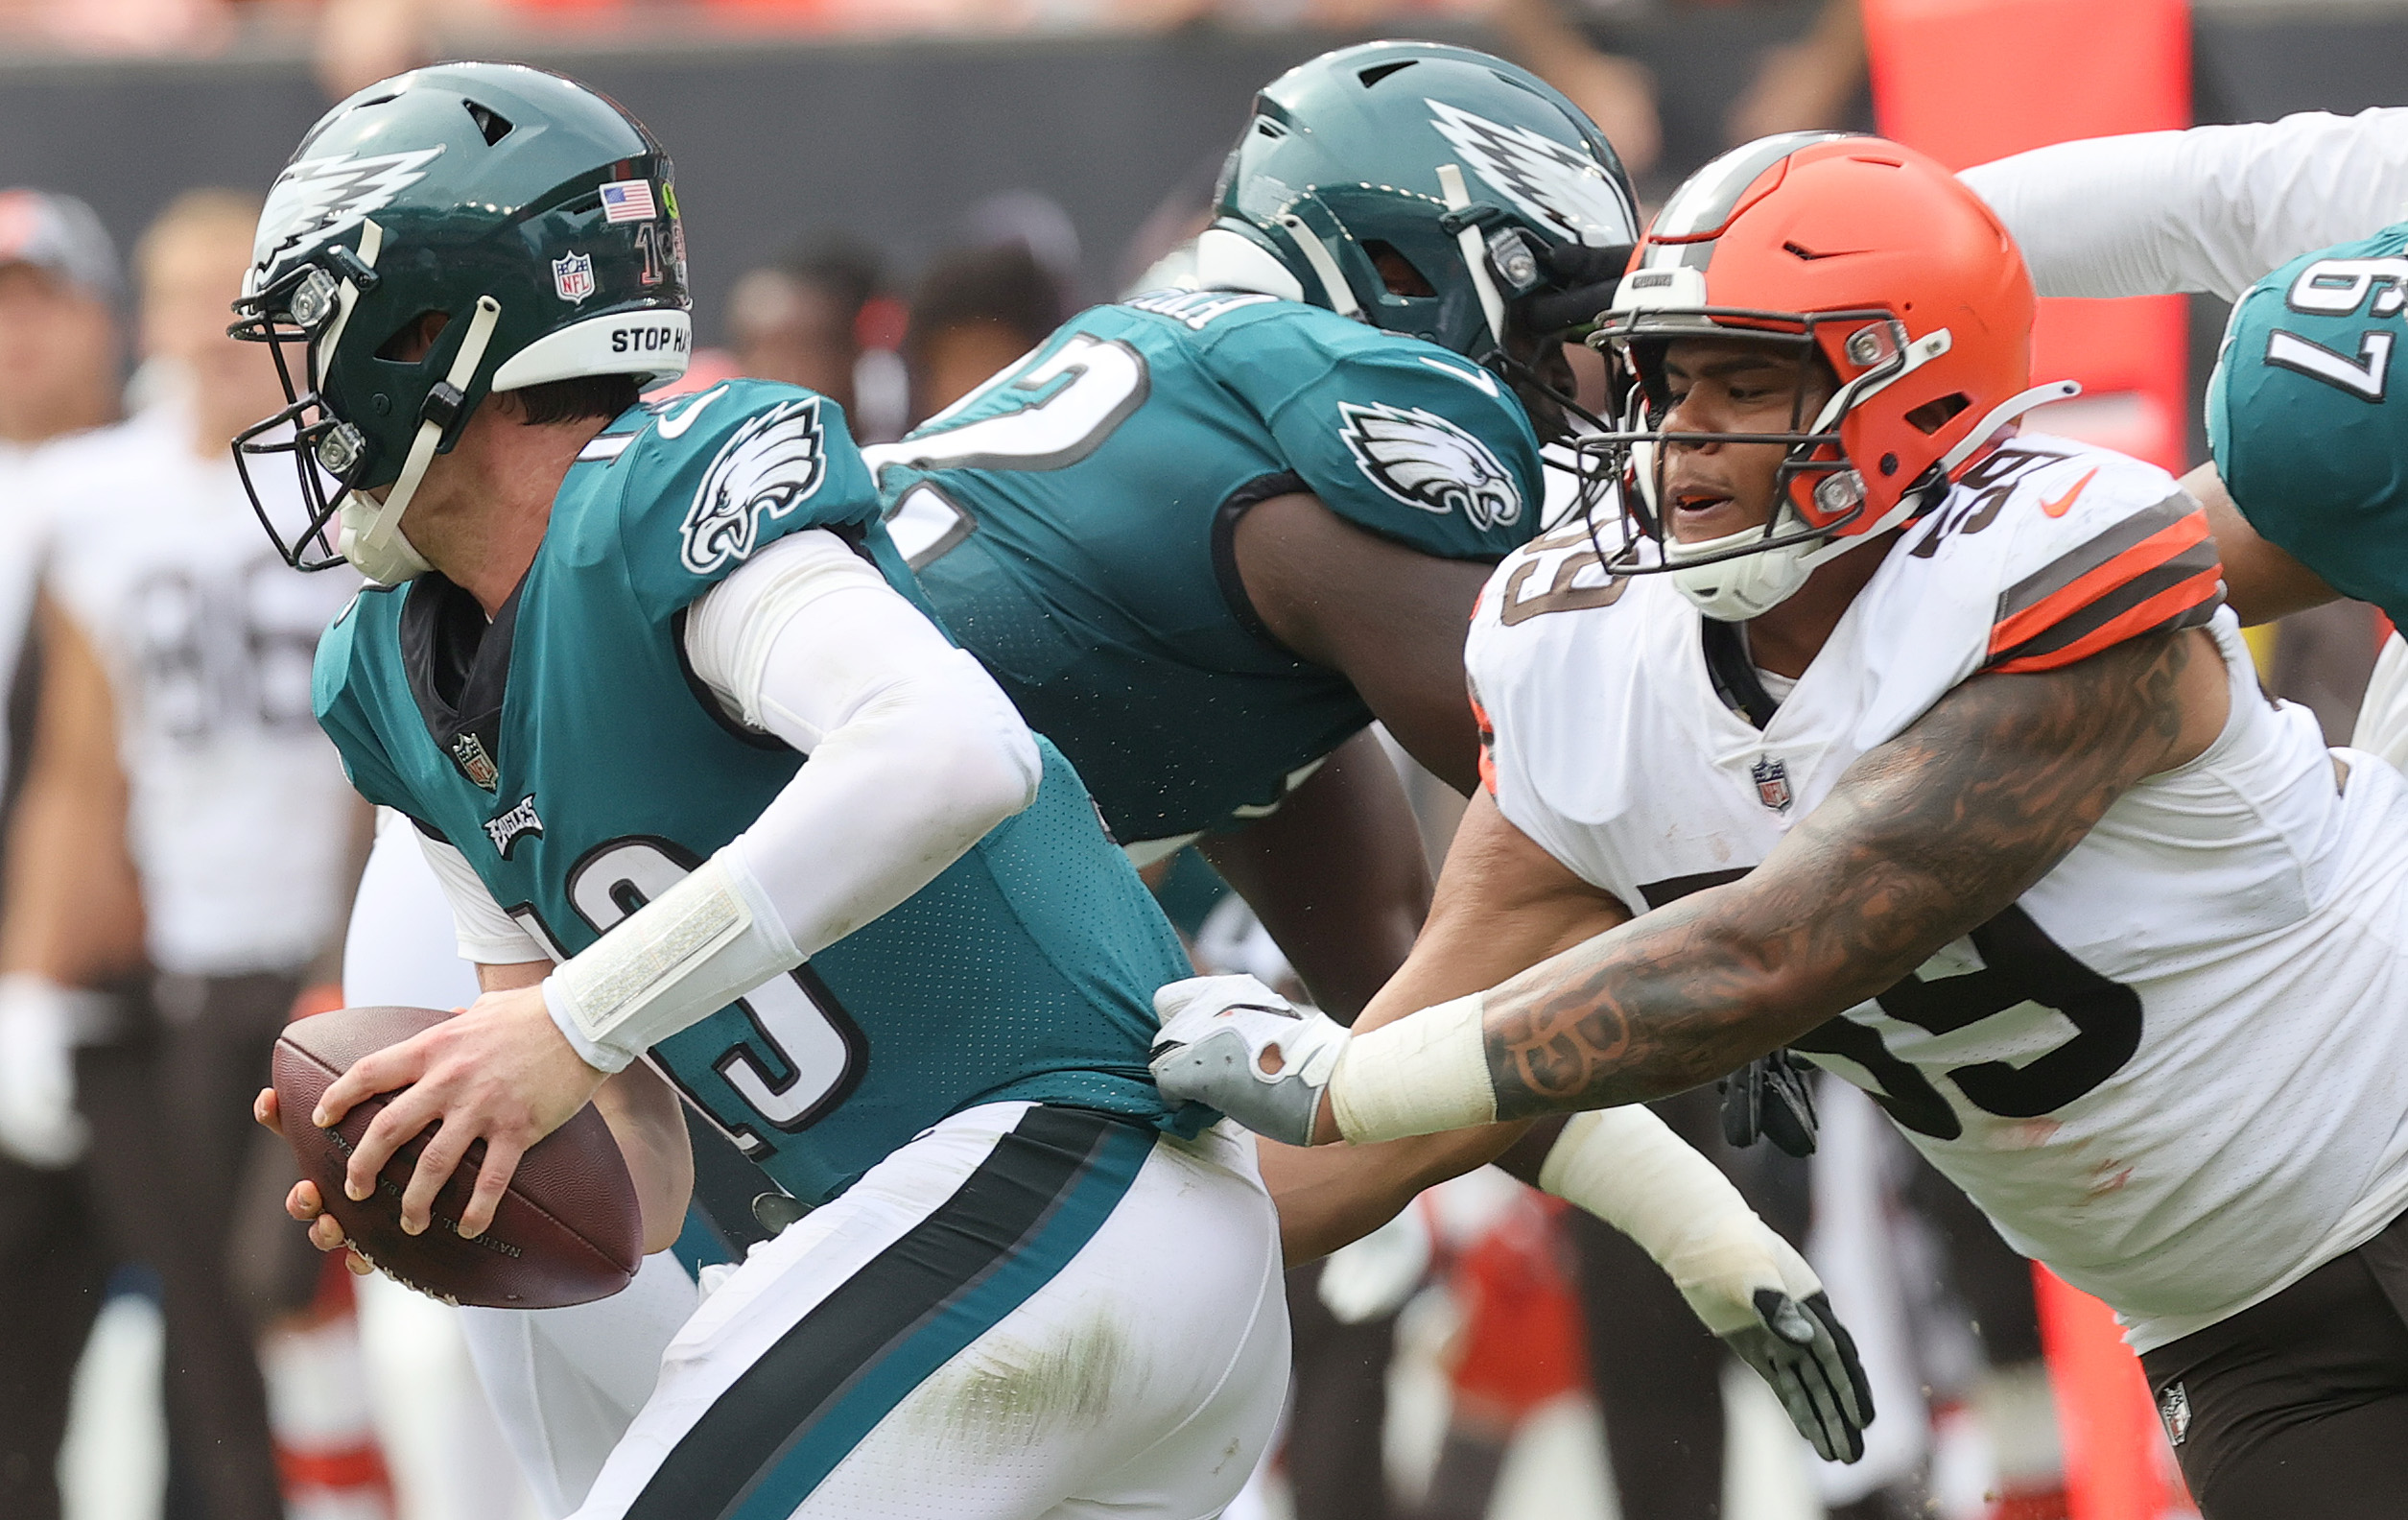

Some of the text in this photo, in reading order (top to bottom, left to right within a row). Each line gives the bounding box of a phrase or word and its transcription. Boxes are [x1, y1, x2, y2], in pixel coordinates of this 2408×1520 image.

[561, 274, 590, 295] NFL
[612, 326, 691, 353] STOP HA
[2263, 254, 2408, 404] 67
[483, 794, 545, 857] EAGLES
[442, 1217, 522, 1259] NATIOAL
